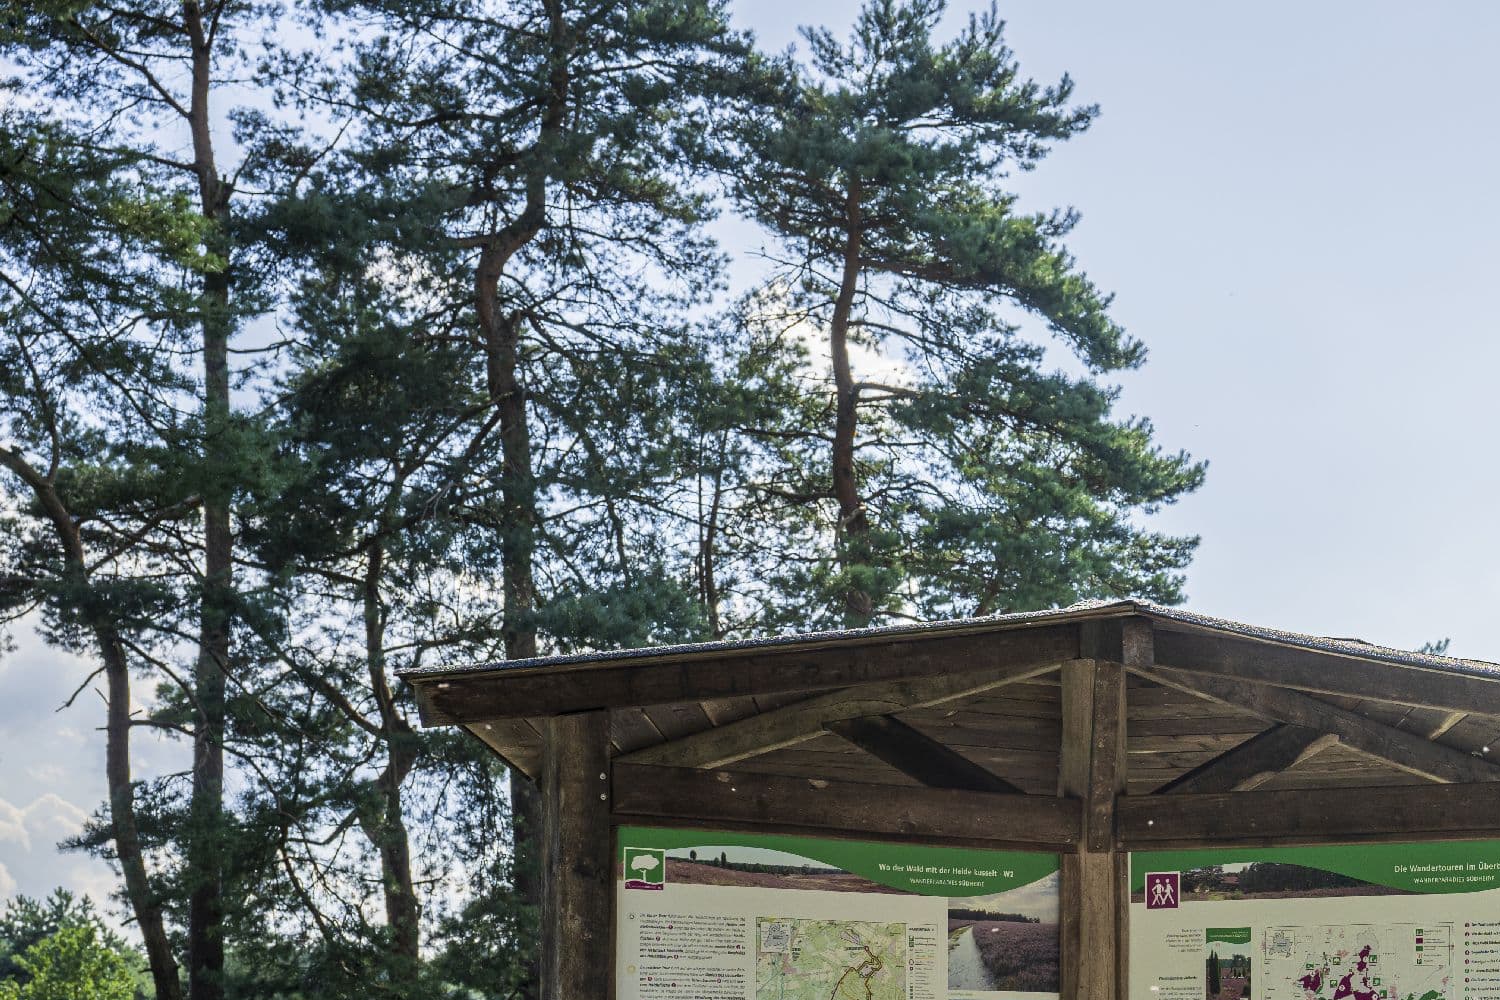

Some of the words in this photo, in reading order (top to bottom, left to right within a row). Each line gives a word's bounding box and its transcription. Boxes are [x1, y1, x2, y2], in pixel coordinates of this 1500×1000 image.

[878, 863, 891, 871] Wo
[892, 864, 905, 872] der
[906, 864, 924, 873] Wald
[925, 866, 938, 874] mit
[939, 866, 951, 875] der
[952, 867, 972, 875] Heide
[1394, 864, 1408, 873] Die
[1409, 863, 1464, 873] Wandertouren
[1466, 863, 1476, 871] im
